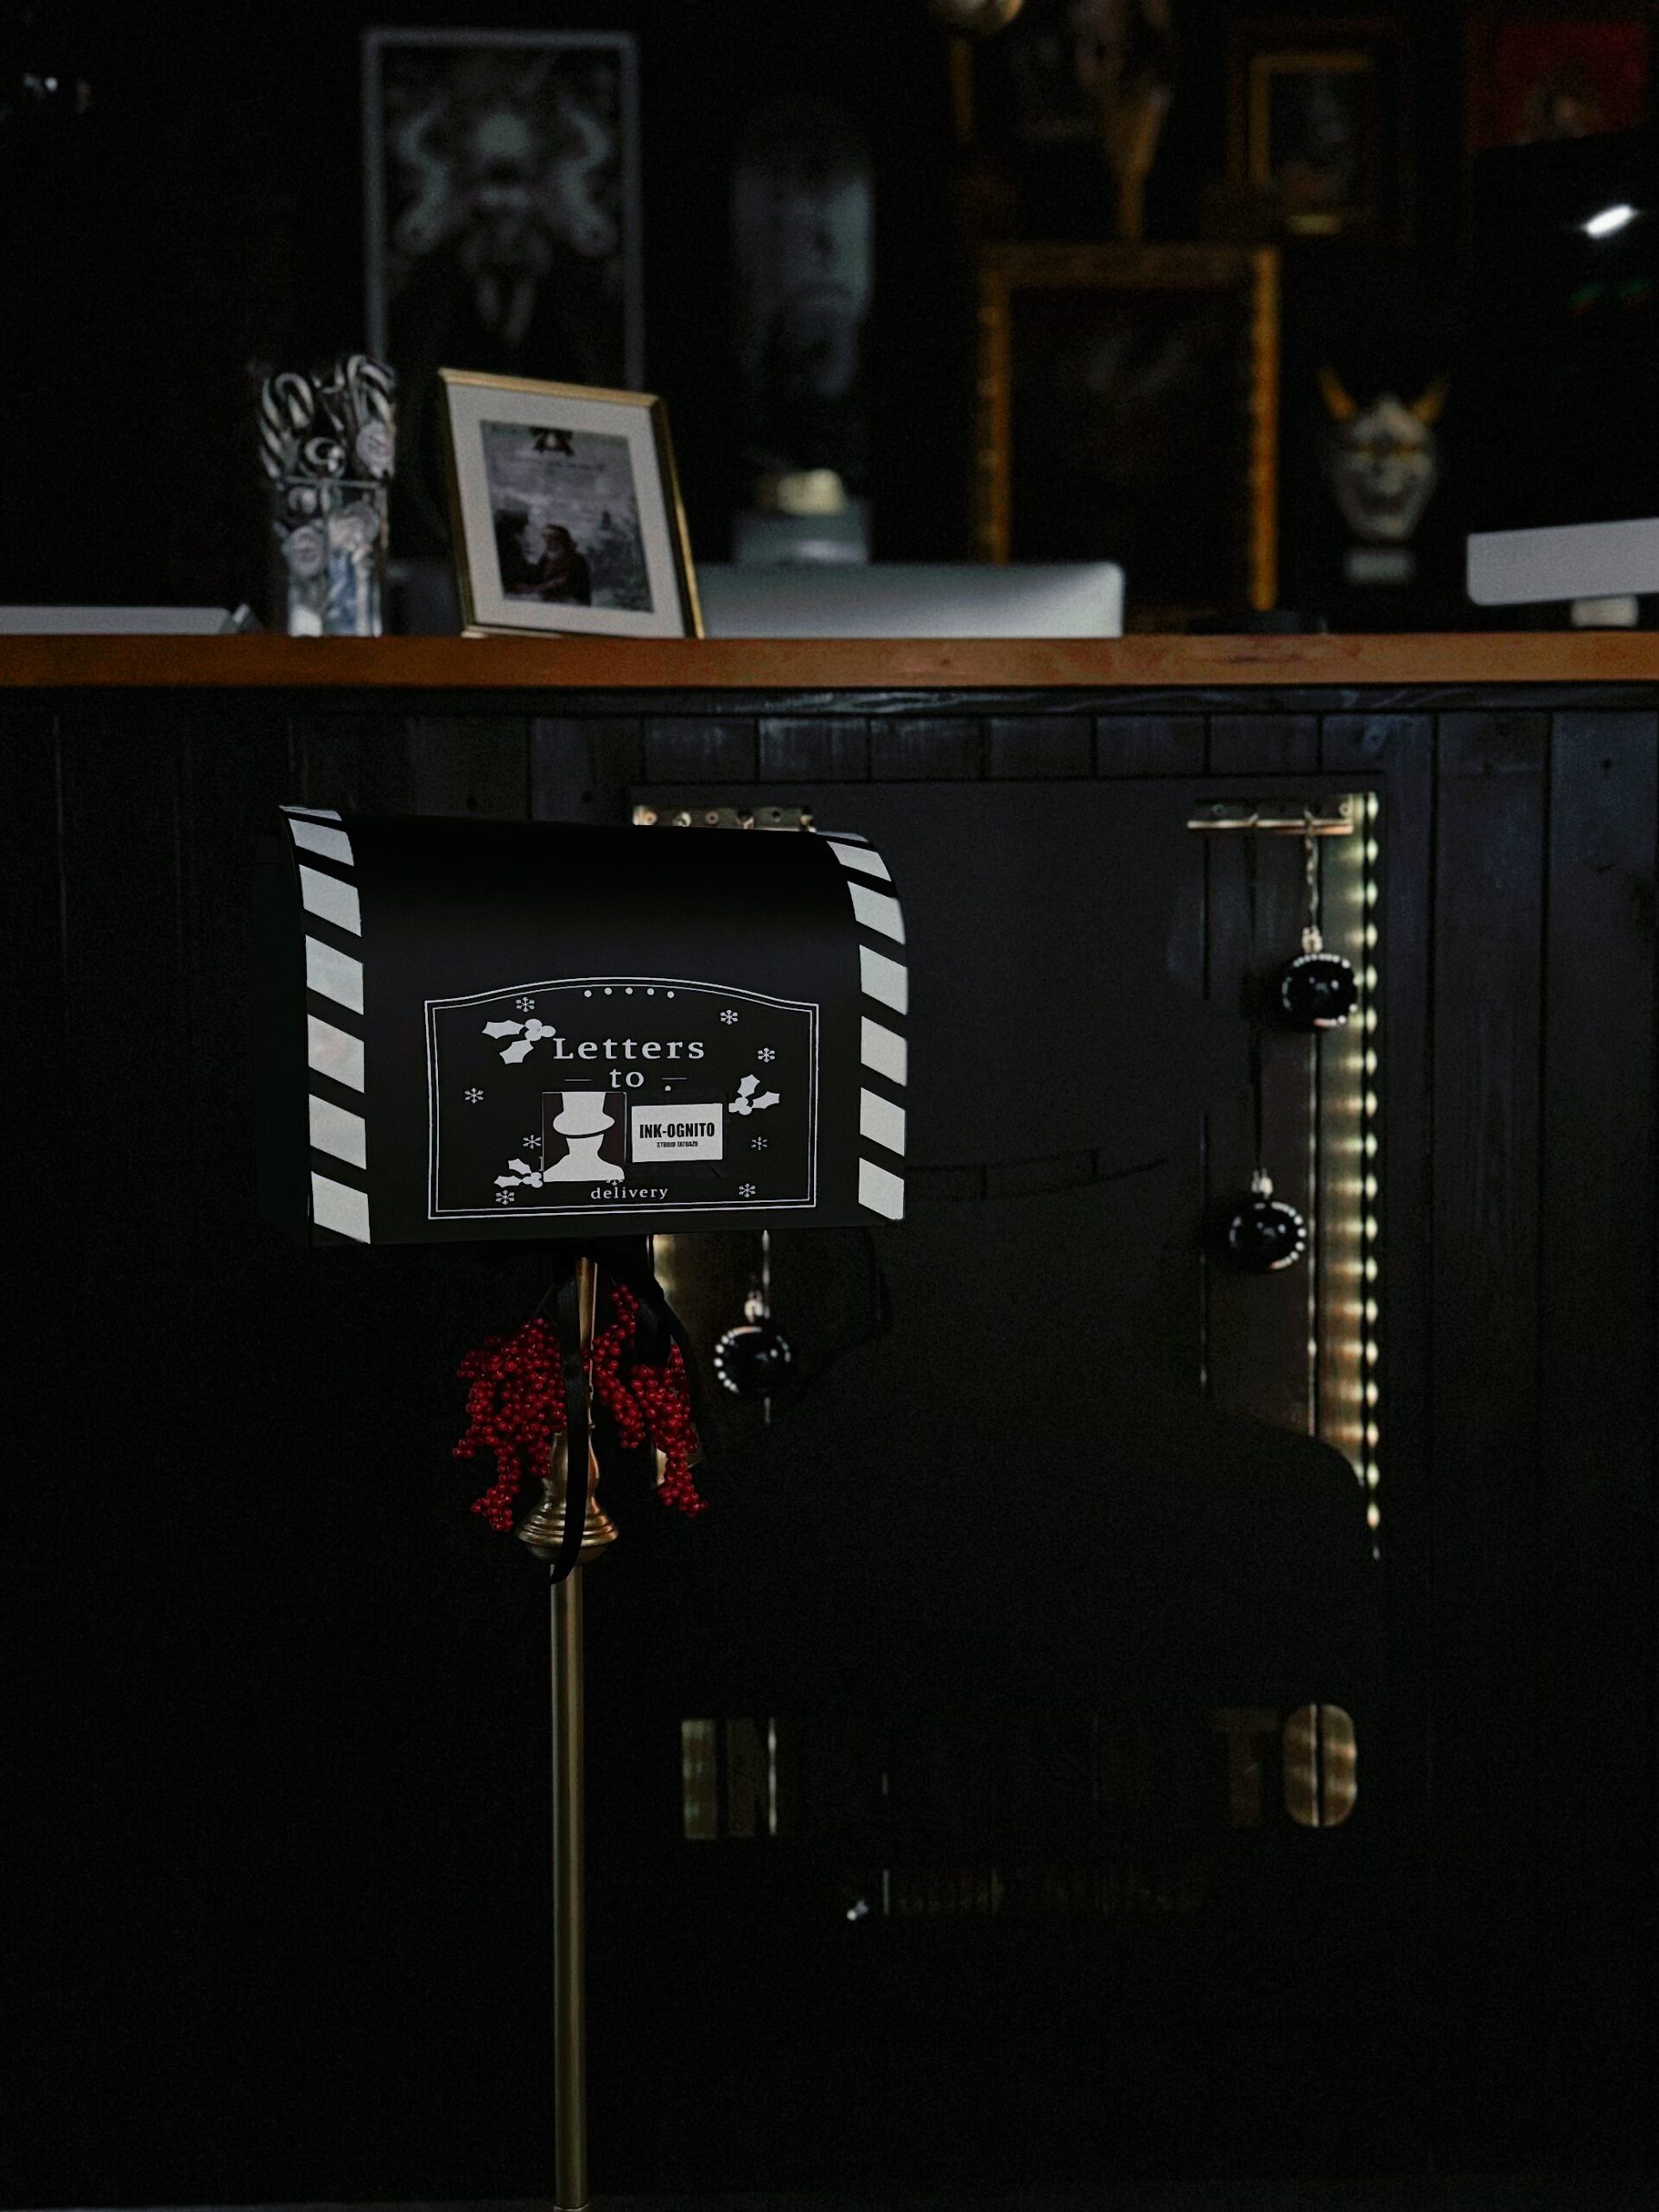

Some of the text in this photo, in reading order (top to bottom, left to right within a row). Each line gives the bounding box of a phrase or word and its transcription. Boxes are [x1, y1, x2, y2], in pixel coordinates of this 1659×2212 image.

[553, 1038, 705, 1060] Letters
[609, 1068, 645, 1089] to
[639, 1122, 715, 1139] INK-OGNITO
[590, 1185, 668, 1200] delivery
